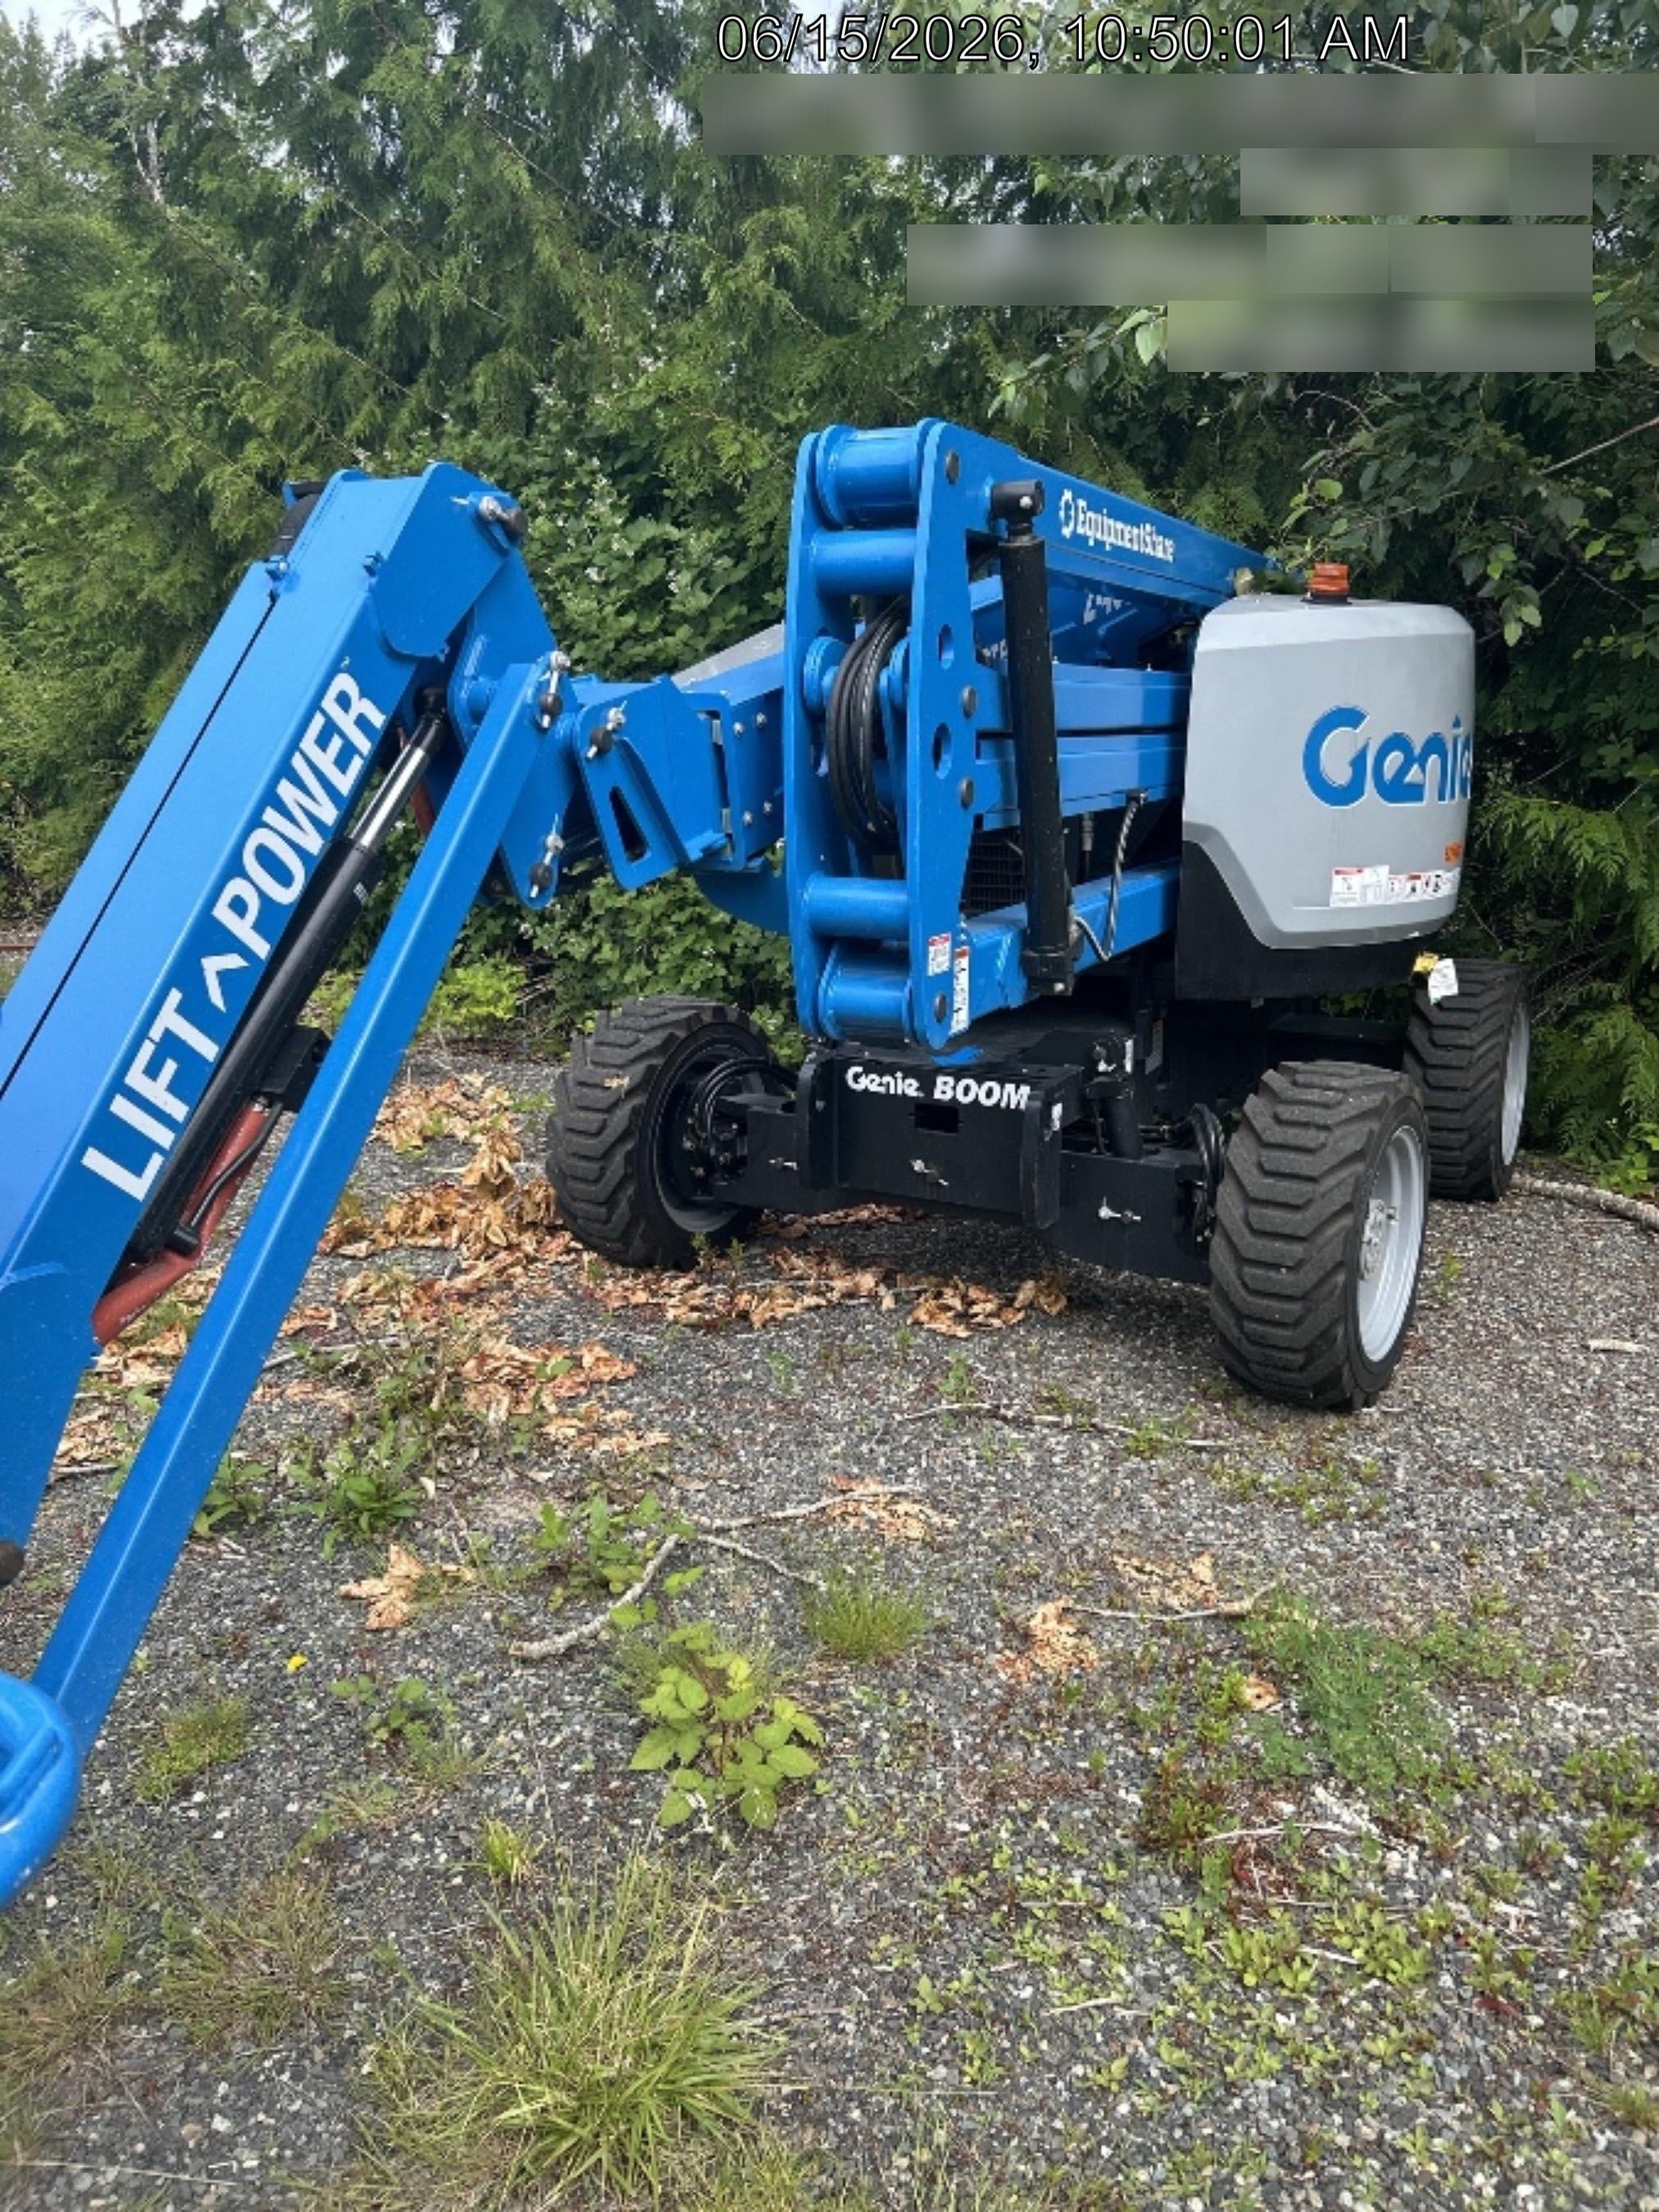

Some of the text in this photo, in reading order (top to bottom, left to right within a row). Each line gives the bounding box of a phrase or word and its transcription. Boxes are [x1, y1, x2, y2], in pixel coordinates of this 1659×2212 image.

[1303, 705, 1472, 808] Genie
[82, 672, 386, 1201] LIFT POWER
[845, 1065, 1031, 1109] Genie BOOM
